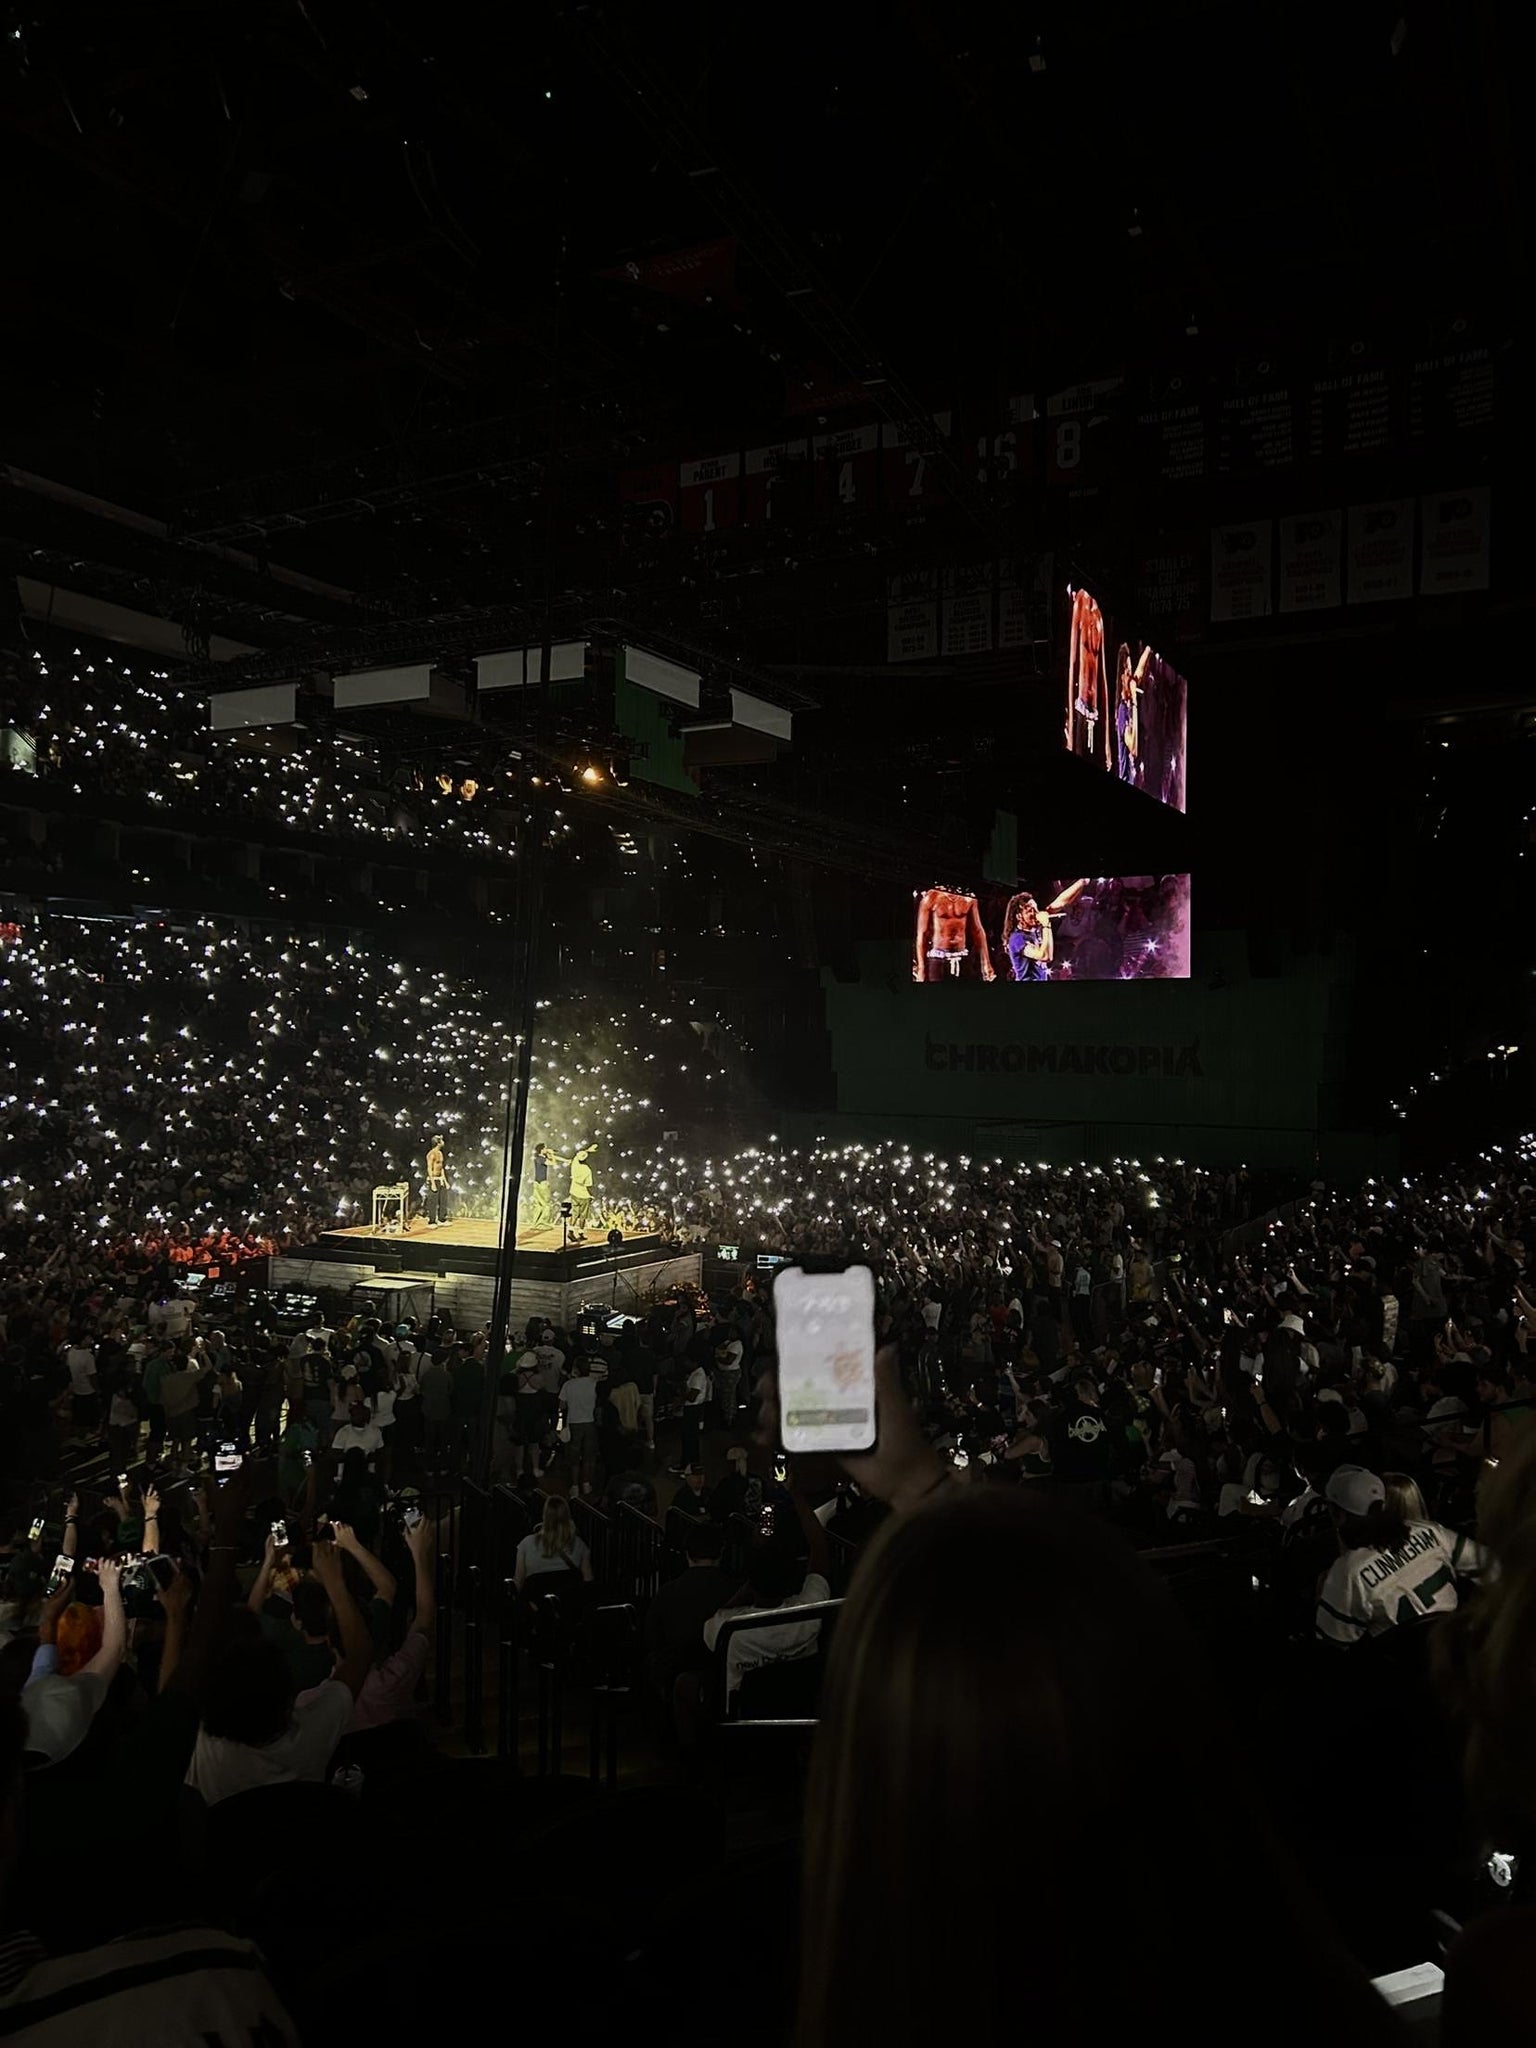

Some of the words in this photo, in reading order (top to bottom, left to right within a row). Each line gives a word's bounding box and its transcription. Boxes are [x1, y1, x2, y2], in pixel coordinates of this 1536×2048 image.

[693, 465, 727, 482] PARENT
[838, 461, 857, 504] 4
[703, 488, 716, 532] 1
[926, 1033, 1204, 1077] CHROMAKOPIA
